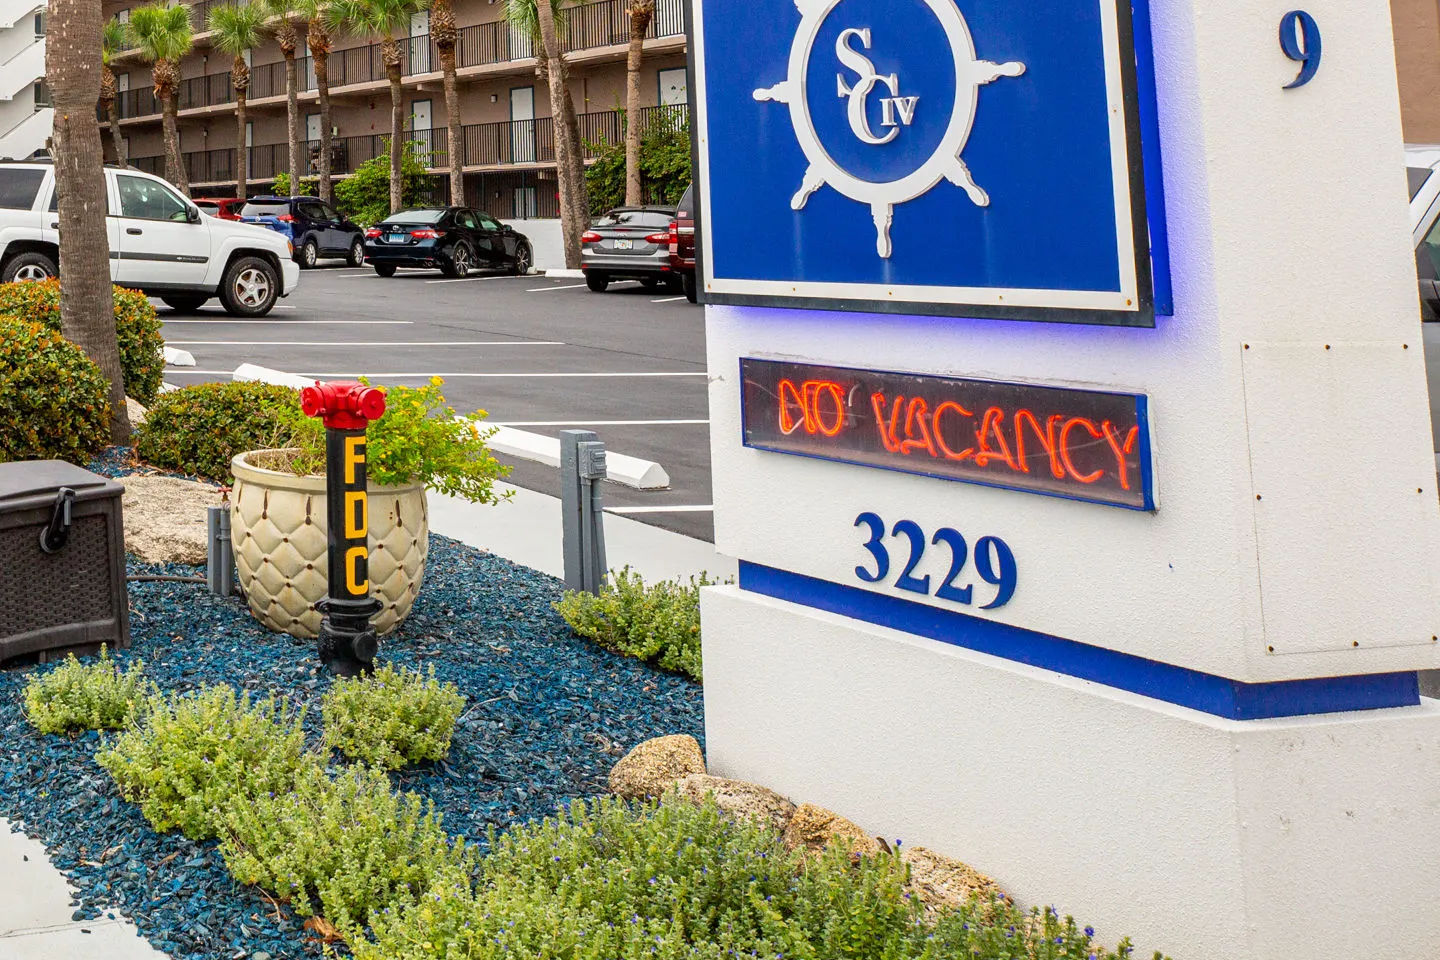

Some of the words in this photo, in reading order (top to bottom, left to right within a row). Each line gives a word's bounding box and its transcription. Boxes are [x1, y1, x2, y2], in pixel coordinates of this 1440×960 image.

[779, 379, 845, 435] NO
[872, 393, 1139, 490] VACANCY
[345, 436, 369, 595] FDC
[854, 512, 1017, 610] 3229
